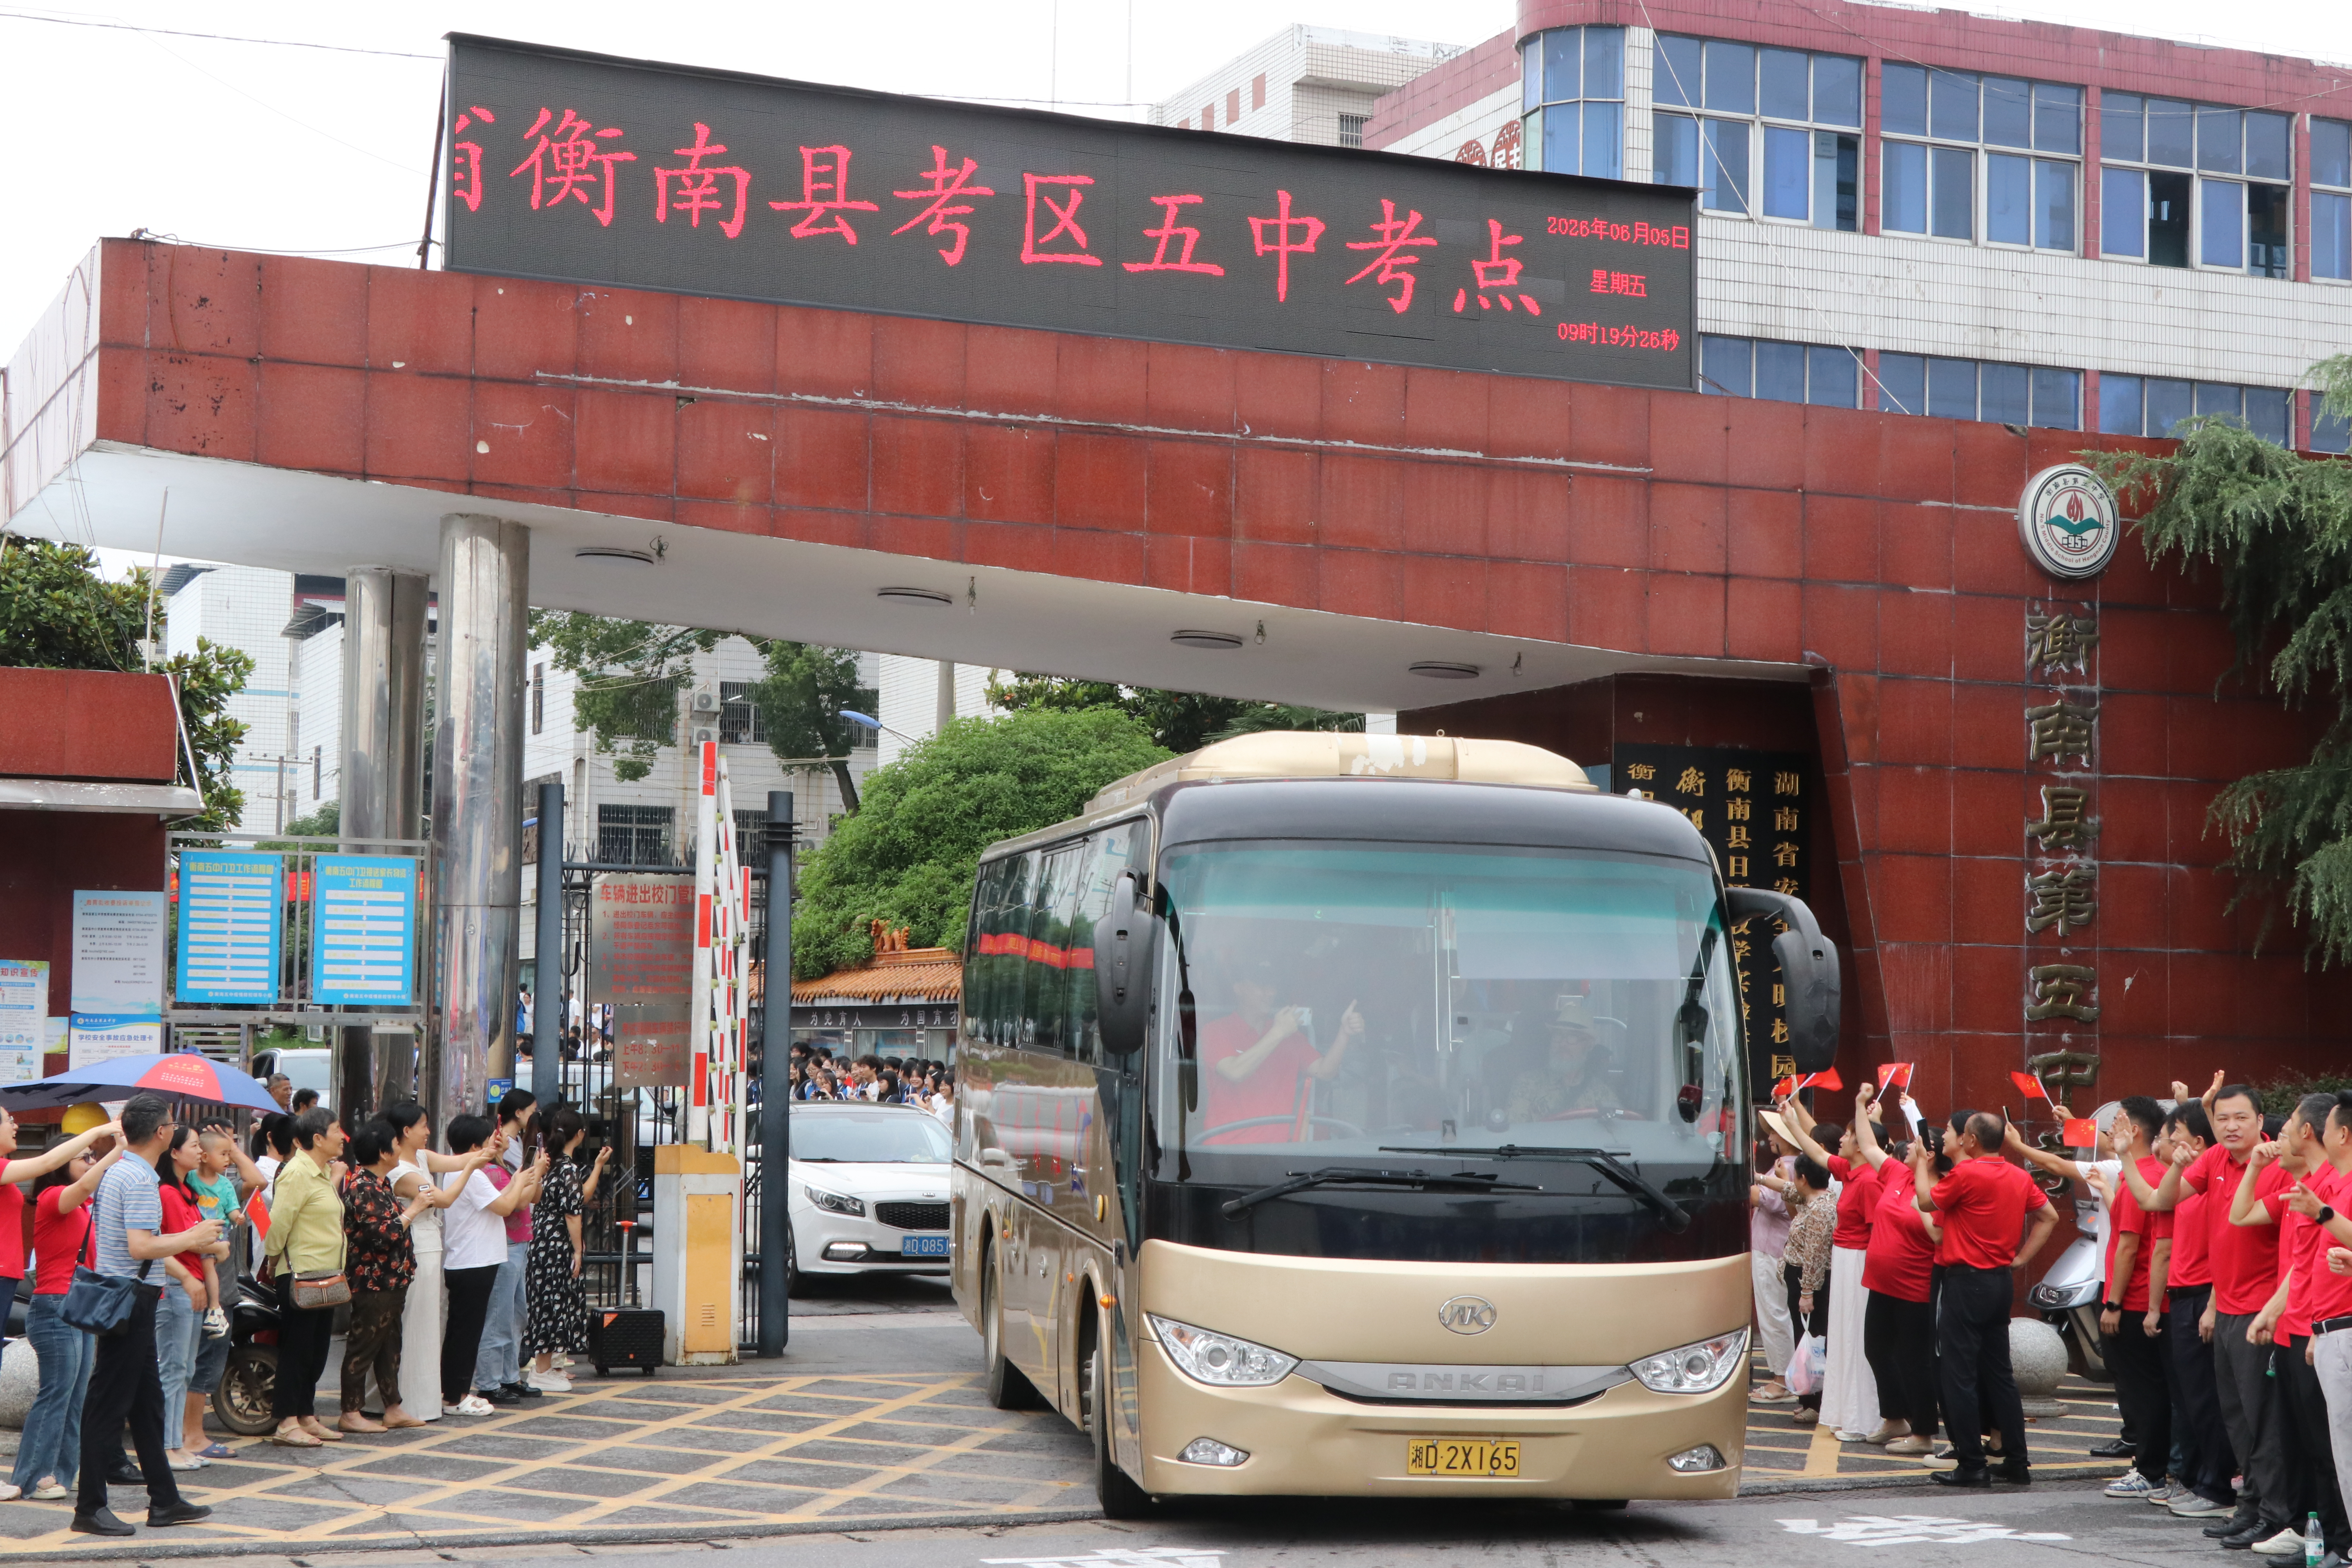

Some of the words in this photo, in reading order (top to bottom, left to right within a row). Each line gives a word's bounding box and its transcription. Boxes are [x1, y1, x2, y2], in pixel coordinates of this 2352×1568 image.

[1548, 217, 1689, 249] 2026年06月05日
[1591, 270, 1646, 297] 星期五
[1558, 323, 1679, 350] 09时19分26秒
[2045, 478, 2105, 500] 衡南县第五中学
[2042, 530, 2054, 552] Middle
[2054, 550, 2074, 563] School
[2082, 544, 2104, 562] Hengnan
[2103, 519, 2111, 543] County
[0, 968, 38, 977] 知识宣传
[810, 1011, 862, 1027] 为党育人
[900, 1008, 958, 1026] 为国育才
[1388, 1373, 1544, 1393] ANKAI
